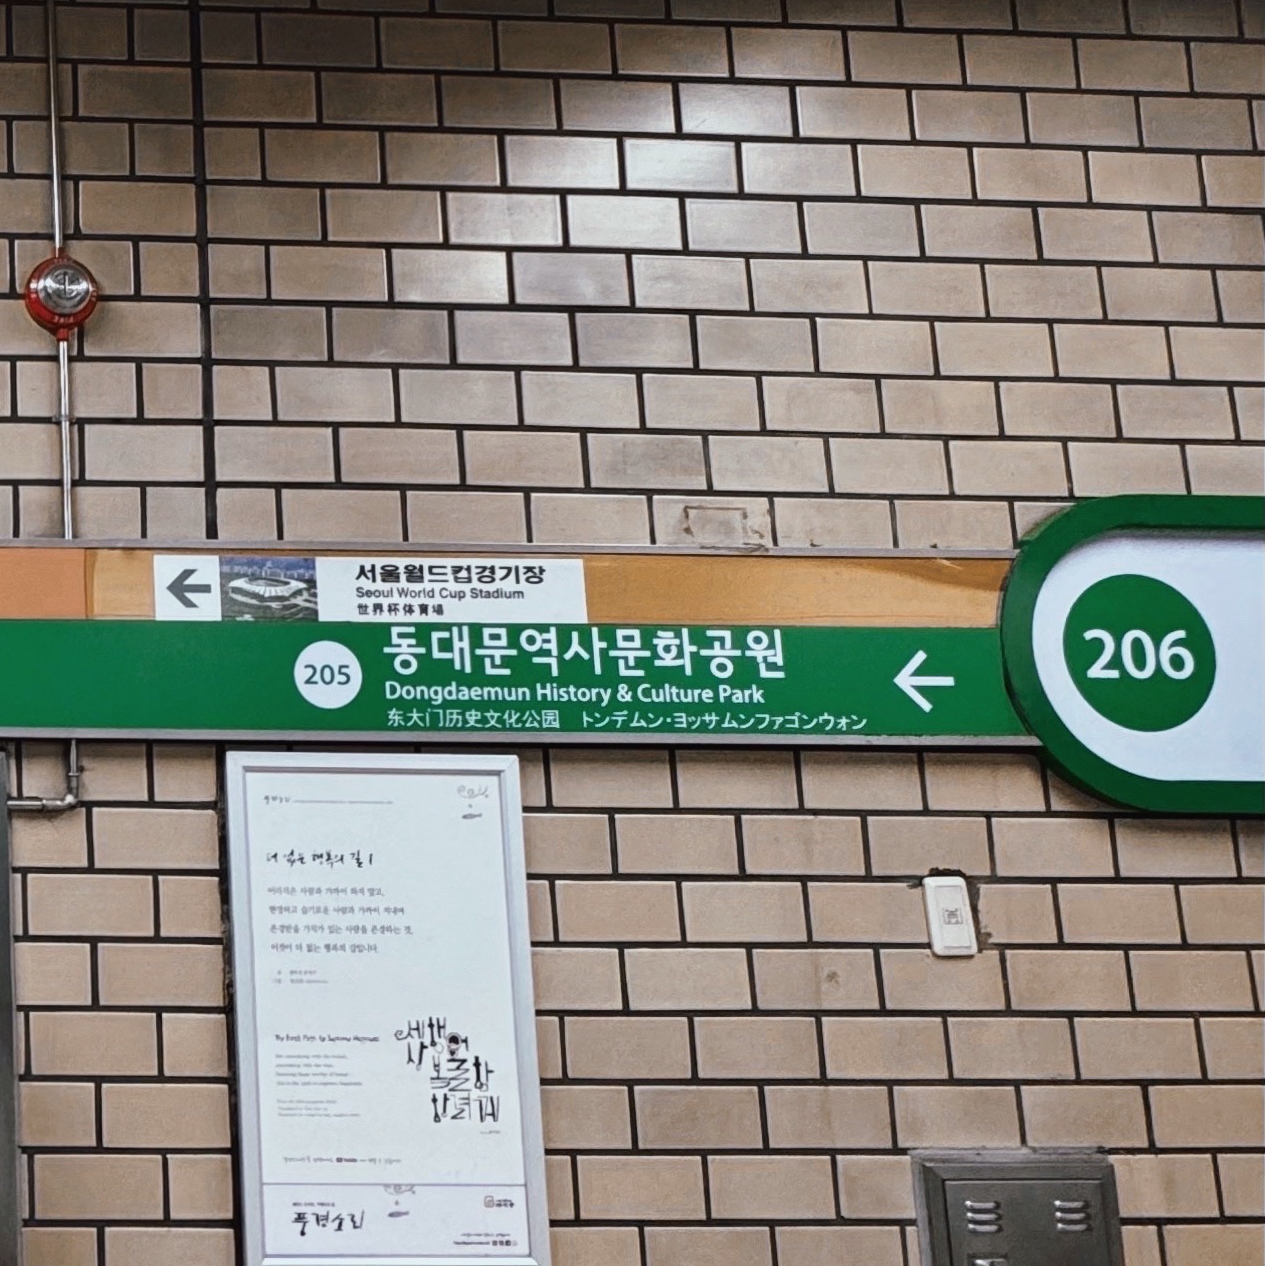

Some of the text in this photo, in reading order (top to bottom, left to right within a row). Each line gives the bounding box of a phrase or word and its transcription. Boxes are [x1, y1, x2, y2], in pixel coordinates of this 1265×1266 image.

[355, 563, 546, 585] 서울월드컵경기장
[356, 587, 525, 602] Seoul World Cup Stadium
[383, 625, 786, 680] 동대문역사문화공원
[1082, 628, 1195, 680] 206
[303, 664, 352, 686] 205
[385, 681, 765, 706] Dongdaemun History & Culture Park
[387, 708, 560, 729] 东大门历史文化公园
